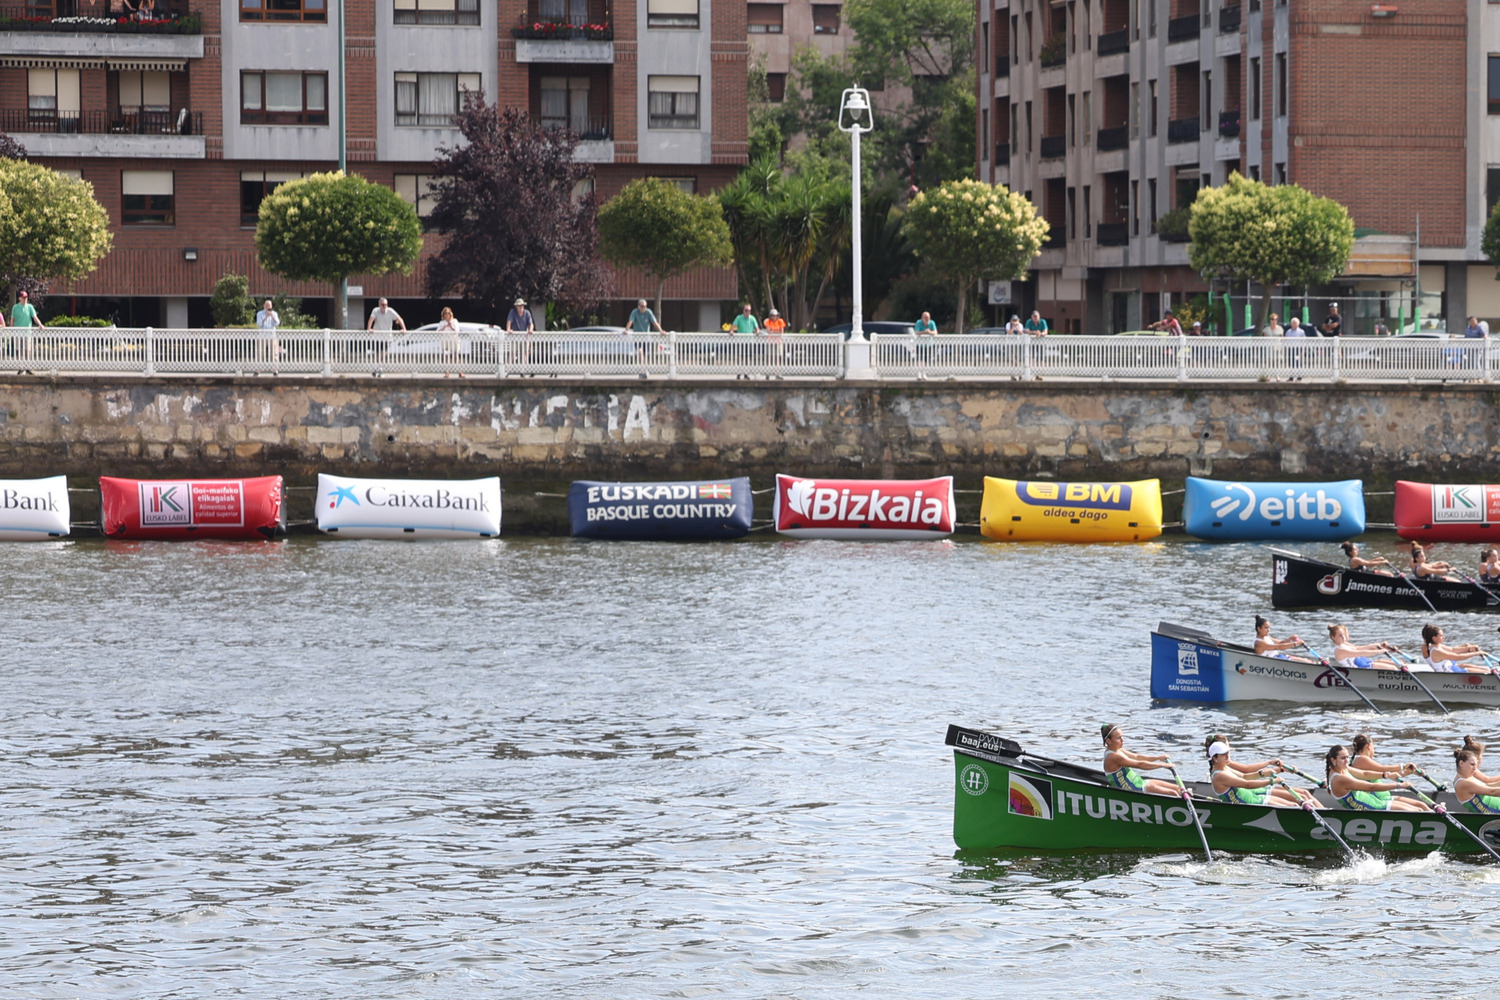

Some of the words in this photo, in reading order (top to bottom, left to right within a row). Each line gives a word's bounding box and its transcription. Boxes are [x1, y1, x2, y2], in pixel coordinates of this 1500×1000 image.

[365, 486, 490, 513] CaixaBank
[587, 484, 697, 501] EUSKADI
[1064, 483, 1121, 503] BM
[586, 504, 651, 521] BASQUE
[653, 503, 736, 519] COUNTRY
[812, 488, 942, 525] Bizkaia
[1043, 507, 1081, 520] aldea
[1084, 508, 1108, 521] dago
[1260, 489, 1342, 521] eitb
[1345, 579, 1392, 595] jamones
[1249, 662, 1307, 679] serviobras
[961, 735, 999, 752] baaj.eus
[1057, 790, 1213, 829] ITURRIOZ
[1310, 817, 1447, 845] aena
